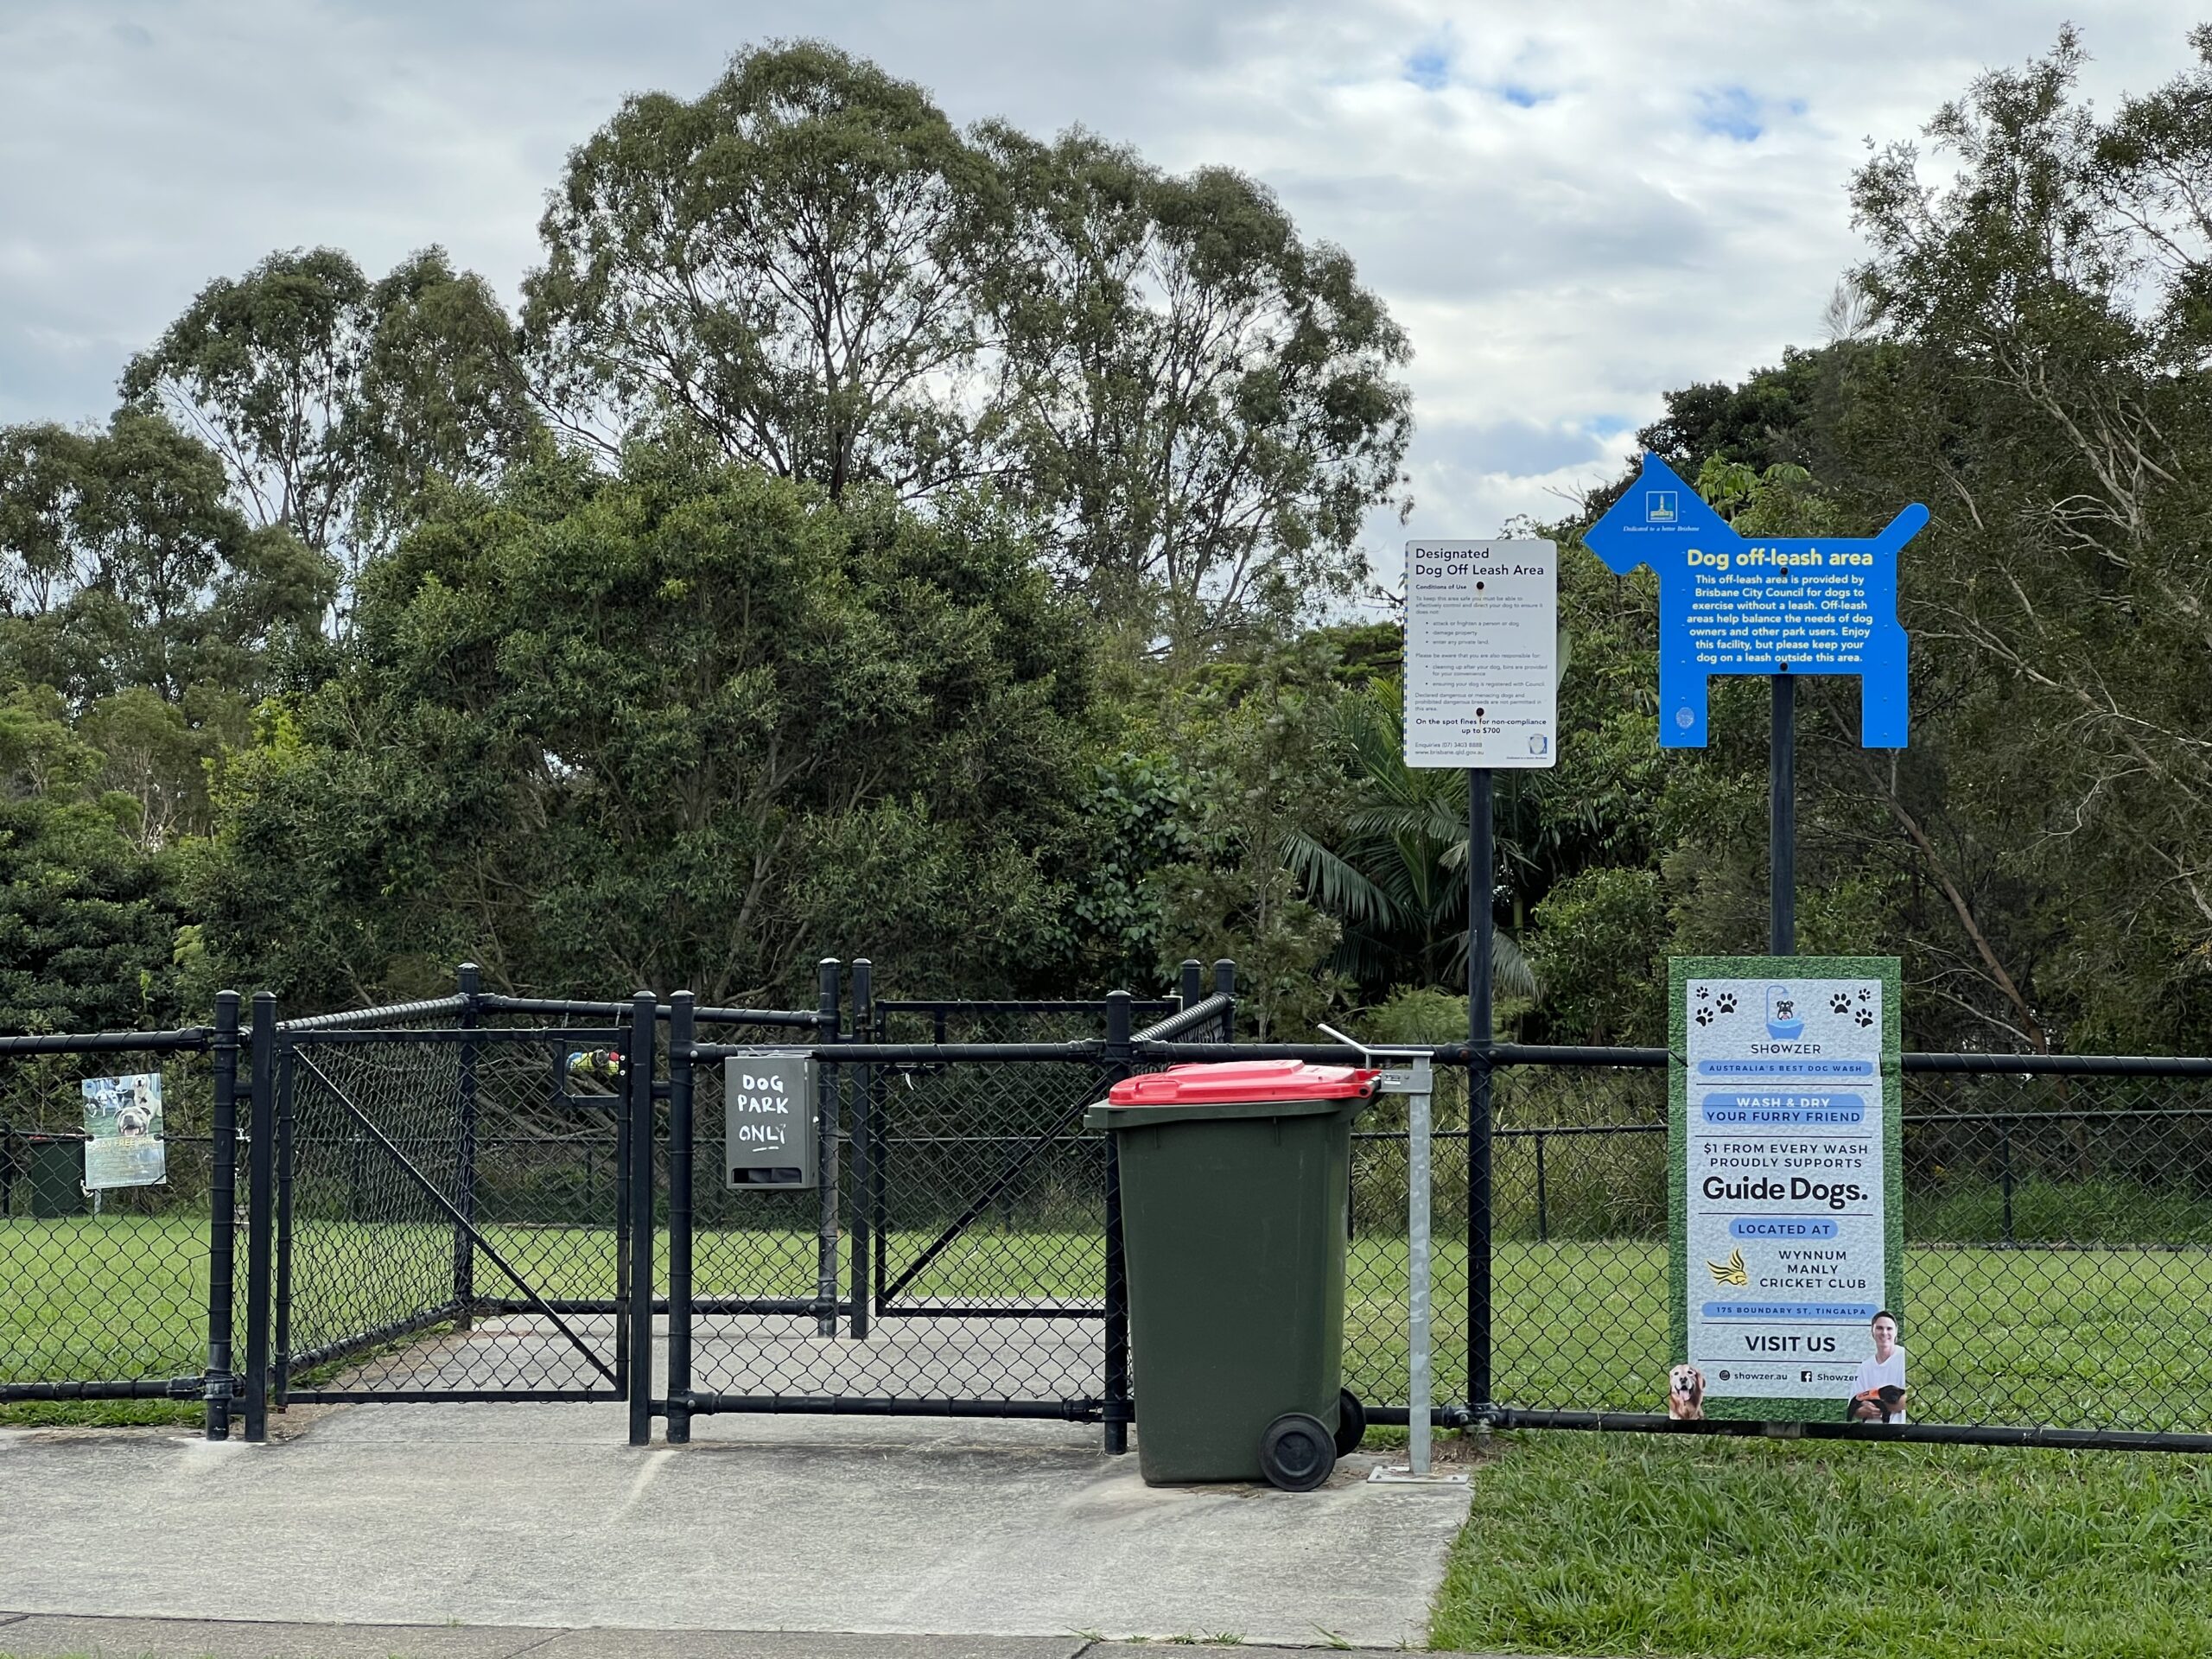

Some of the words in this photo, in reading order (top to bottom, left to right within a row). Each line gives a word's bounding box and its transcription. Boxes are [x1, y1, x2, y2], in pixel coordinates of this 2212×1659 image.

[1416, 548, 1489, 562] Designated
[1688, 549, 1729, 570] Dog
[1736, 548, 1822, 567] off-leash
[1829, 553, 1873, 566] area
[1416, 564, 1442, 577] Dog
[1447, 564, 1468, 575] Off
[1473, 564, 1509, 575] Leash
[1513, 565, 1543, 575] Area
[1695, 575, 1716, 584] This
[1719, 575, 1763, 584] off-leash
[1791, 575, 1799, 584] is
[1802, 575, 1848, 586] provided
[1852, 575, 1864, 586] by
[1695, 588, 1739, 597] Brisbane
[1742, 588, 1763, 599] City
[1765, 588, 1803, 597] Council
[1807, 588, 1821, 596] for
[1825, 588, 1851, 599] dogs
[1692, 601, 1733, 610] exercise
[1737, 601, 1776, 609] without
[1789, 601, 1817, 609] leash.
[1821, 601, 1867, 609] Off-leash
[1717, 613, 1739, 625] help
[1742, 613, 1782, 623] balance
[1784, 613, 1802, 623] the
[1804, 613, 1835, 623] needs
[1838, 613, 1849, 623] of
[1852, 613, 1873, 625] dog
[1729, 626, 1749, 636] and
[1751, 626, 1780, 636] other
[1783, 626, 1805, 638] park
[1841, 626, 1870, 639] Enjoy
[1695, 639, 1714, 649] this
[1717, 639, 1751, 651] facility,
[1756, 639, 1773, 649] but
[1776, 639, 1809, 651] please
[1812, 639, 1838, 651] keep
[1840, 642, 1864, 651] your
[1696, 652, 1717, 664] dog
[1745, 652, 1771, 662] leash
[1775, 652, 1813, 663] outside
[1815, 652, 1834, 662] this
[1751, 1044, 1821, 1054] SHOWZER
[743, 1074, 783, 1093] DOG
[738, 1094, 788, 1114] PARK
[1737, 1097, 1781, 1107] WASH
[1786, 1098, 1795, 1107] &
[1801, 1098, 1830, 1107] DRY
[1707, 1112, 1746, 1121] YOUR
[1752, 1112, 1800, 1122] FURRY
[1806, 1112, 1859, 1122] FRIEND
[739, 1124, 786, 1144] ONLY
[114, 1138, 135, 1147] FREE
[1704, 1142, 1717, 1154] $1
[1724, 1144, 1764, 1154] FROM
[1770, 1144, 1818, 1154] EVERY
[1823, 1145, 1867, 1154] WASH
[1710, 1158, 1778, 1167] PROUDLY
[1784, 1158, 1861, 1168] SUPPORTS
[1703, 1176, 1785, 1200] Guide
[1791, 1177, 1868, 1210] Dogs.
[1738, 1224, 1806, 1234] LOCATED
[1812, 1225, 1830, 1235] AT
[1778, 1250, 1846, 1260] WYNNUM
[1788, 1264, 1838, 1274] MANLY
[1760, 1278, 1822, 1287] CRICKET
[1828, 1279, 1866, 1288] CLUB
[1745, 1336, 1801, 1351] VISIT
[1807, 1337, 1835, 1352] US
